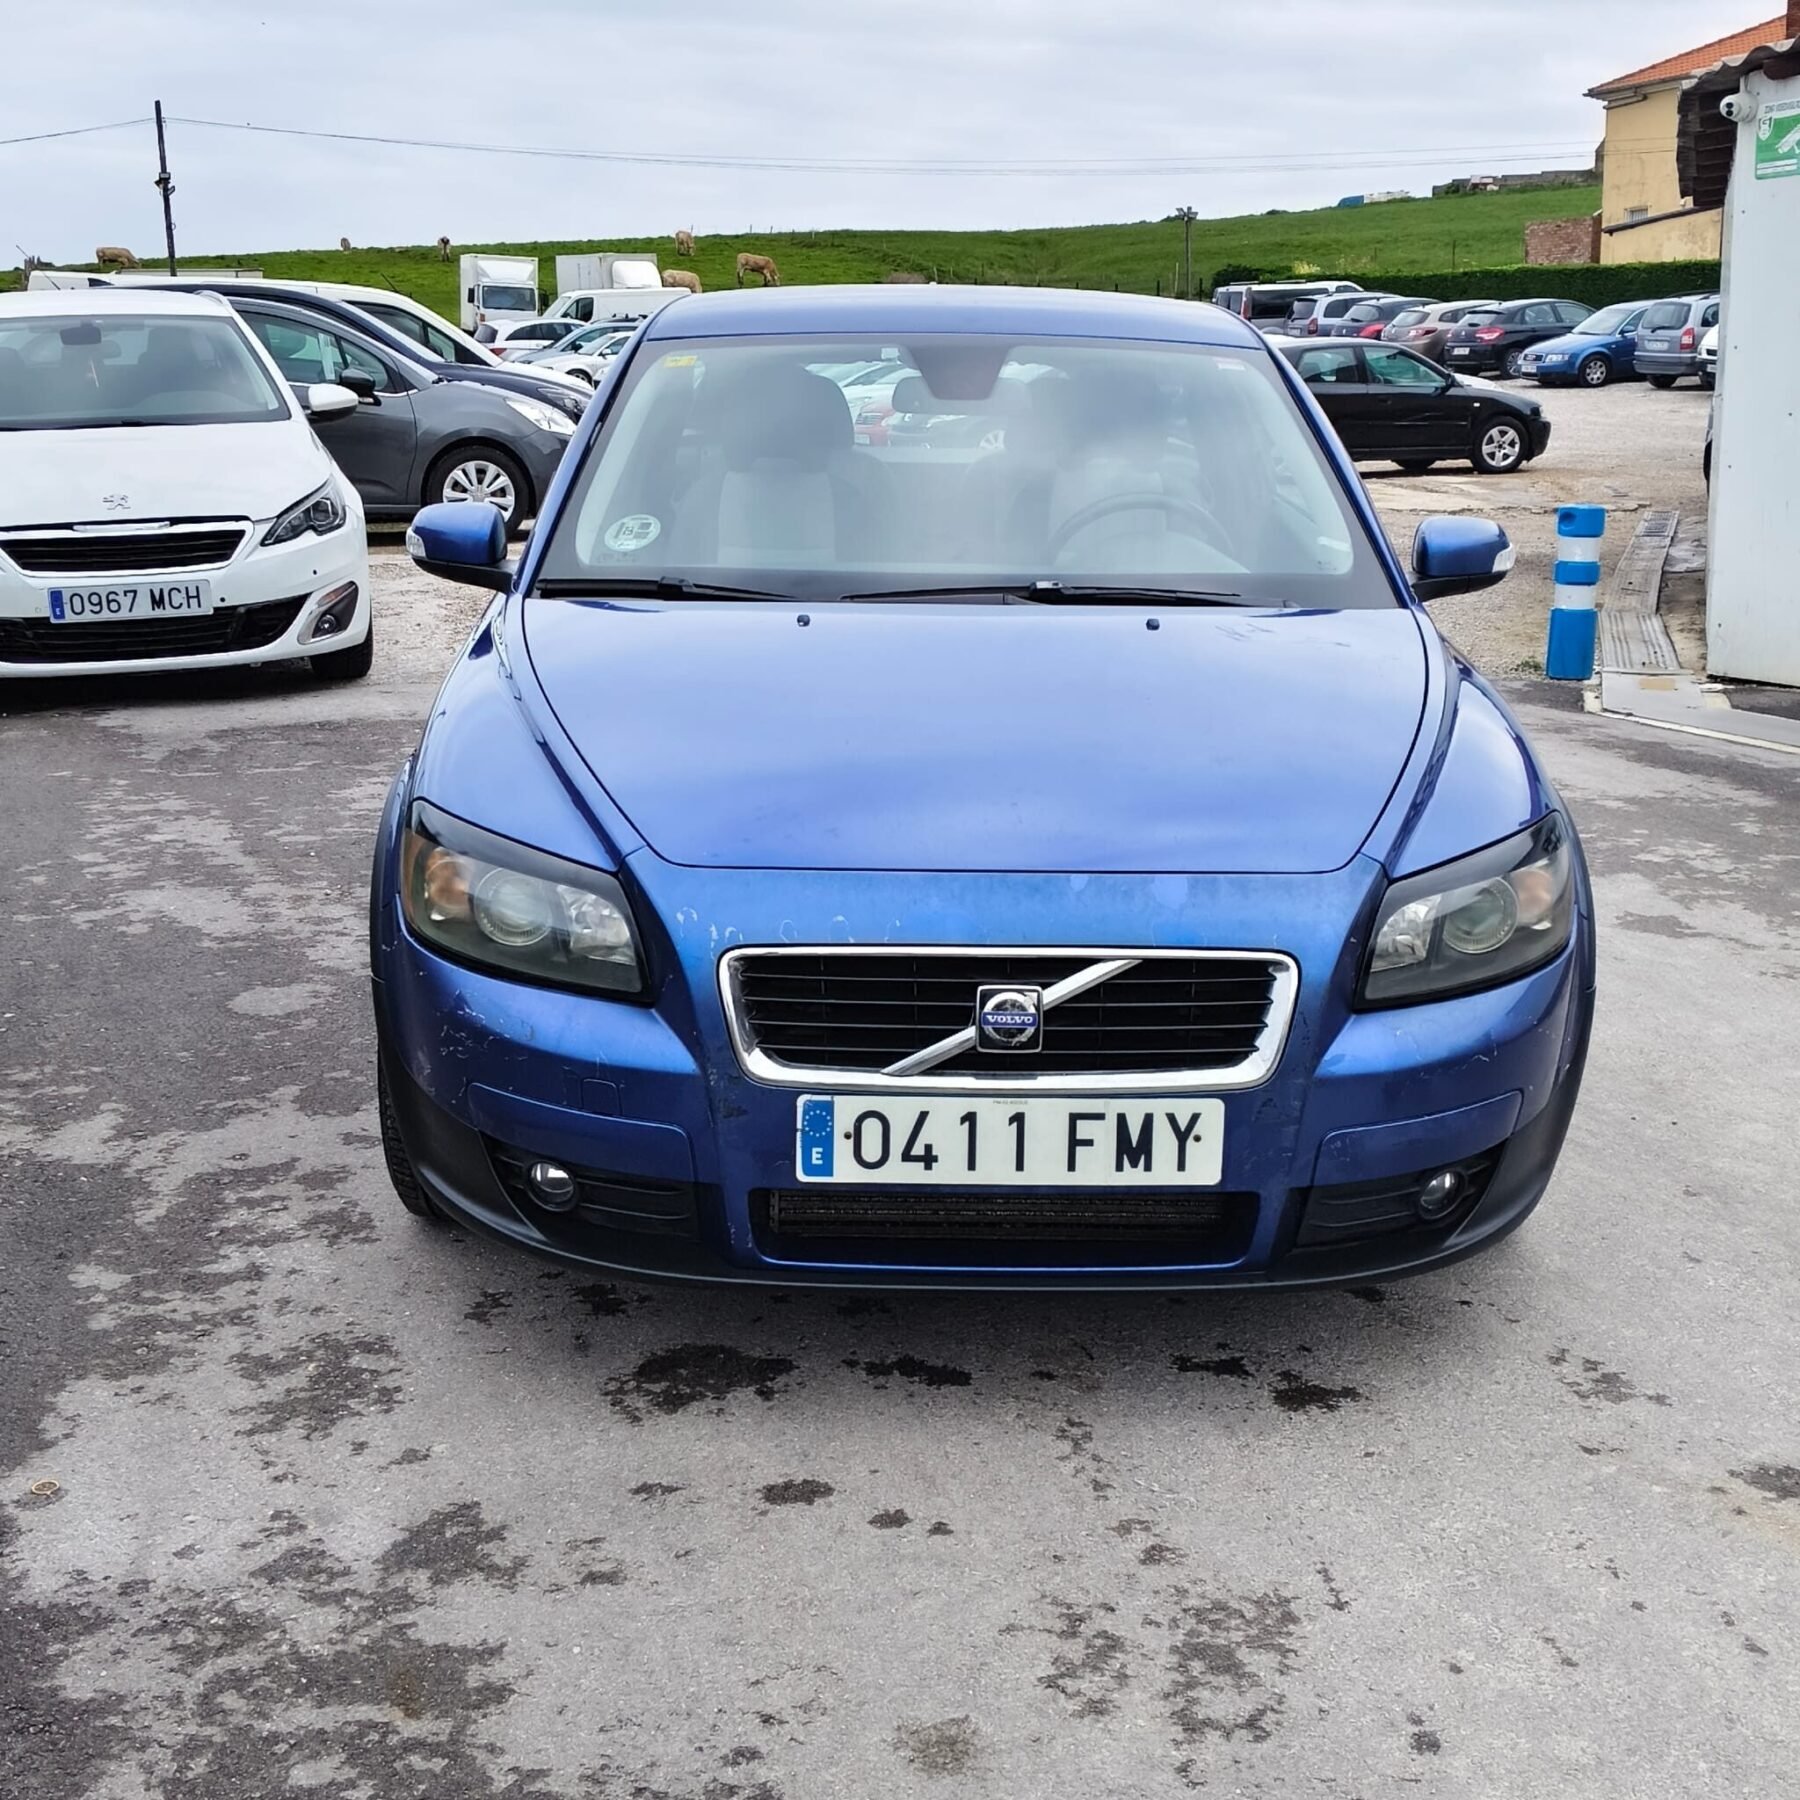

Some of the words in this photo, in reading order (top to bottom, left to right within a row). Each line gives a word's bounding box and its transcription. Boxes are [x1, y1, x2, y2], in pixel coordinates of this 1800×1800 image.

[69, 589, 138, 616] 0967
[149, 585, 202, 611] MCH
[986, 1015, 1034, 1024] VOLVO
[853, 1109, 1026, 1172] 0411
[1066, 1112, 1202, 1173] FMY
[811, 1147, 824, 1165] E
